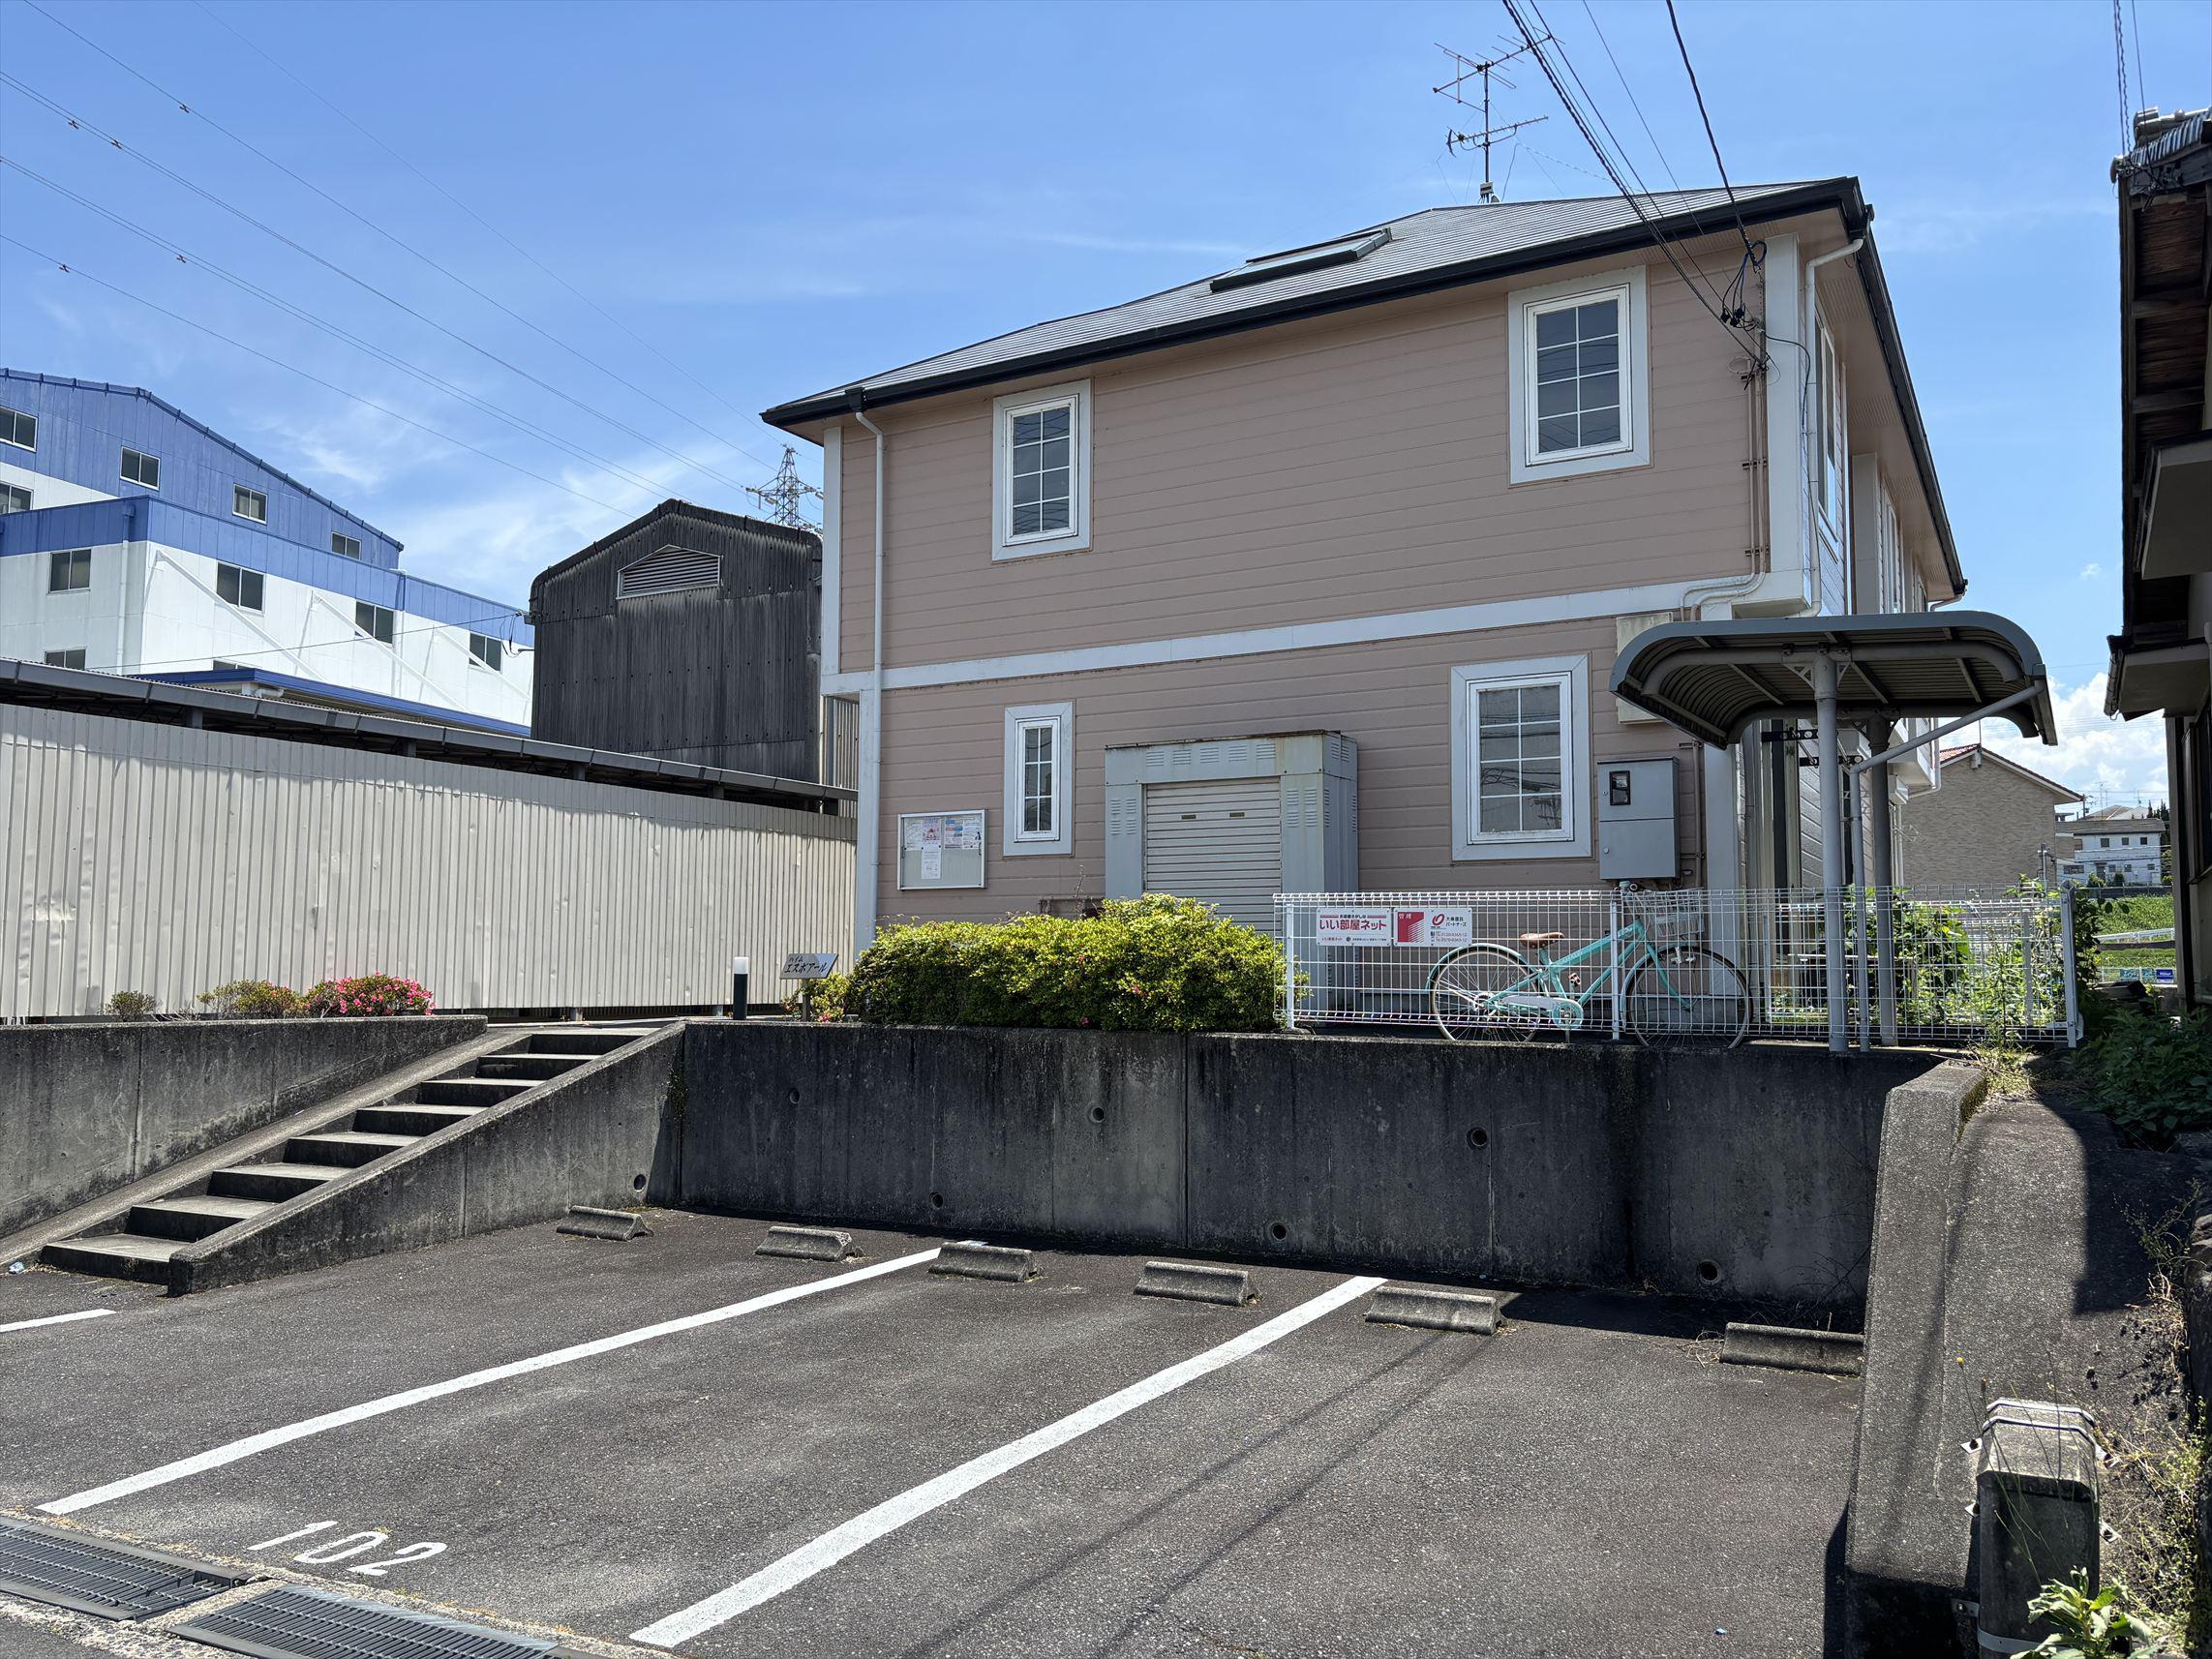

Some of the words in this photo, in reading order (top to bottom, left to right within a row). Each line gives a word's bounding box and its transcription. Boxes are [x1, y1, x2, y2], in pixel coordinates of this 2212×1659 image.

[1319, 920, 1387, 930] いい部屋ネット
[246, 1520, 448, 1576] 102
